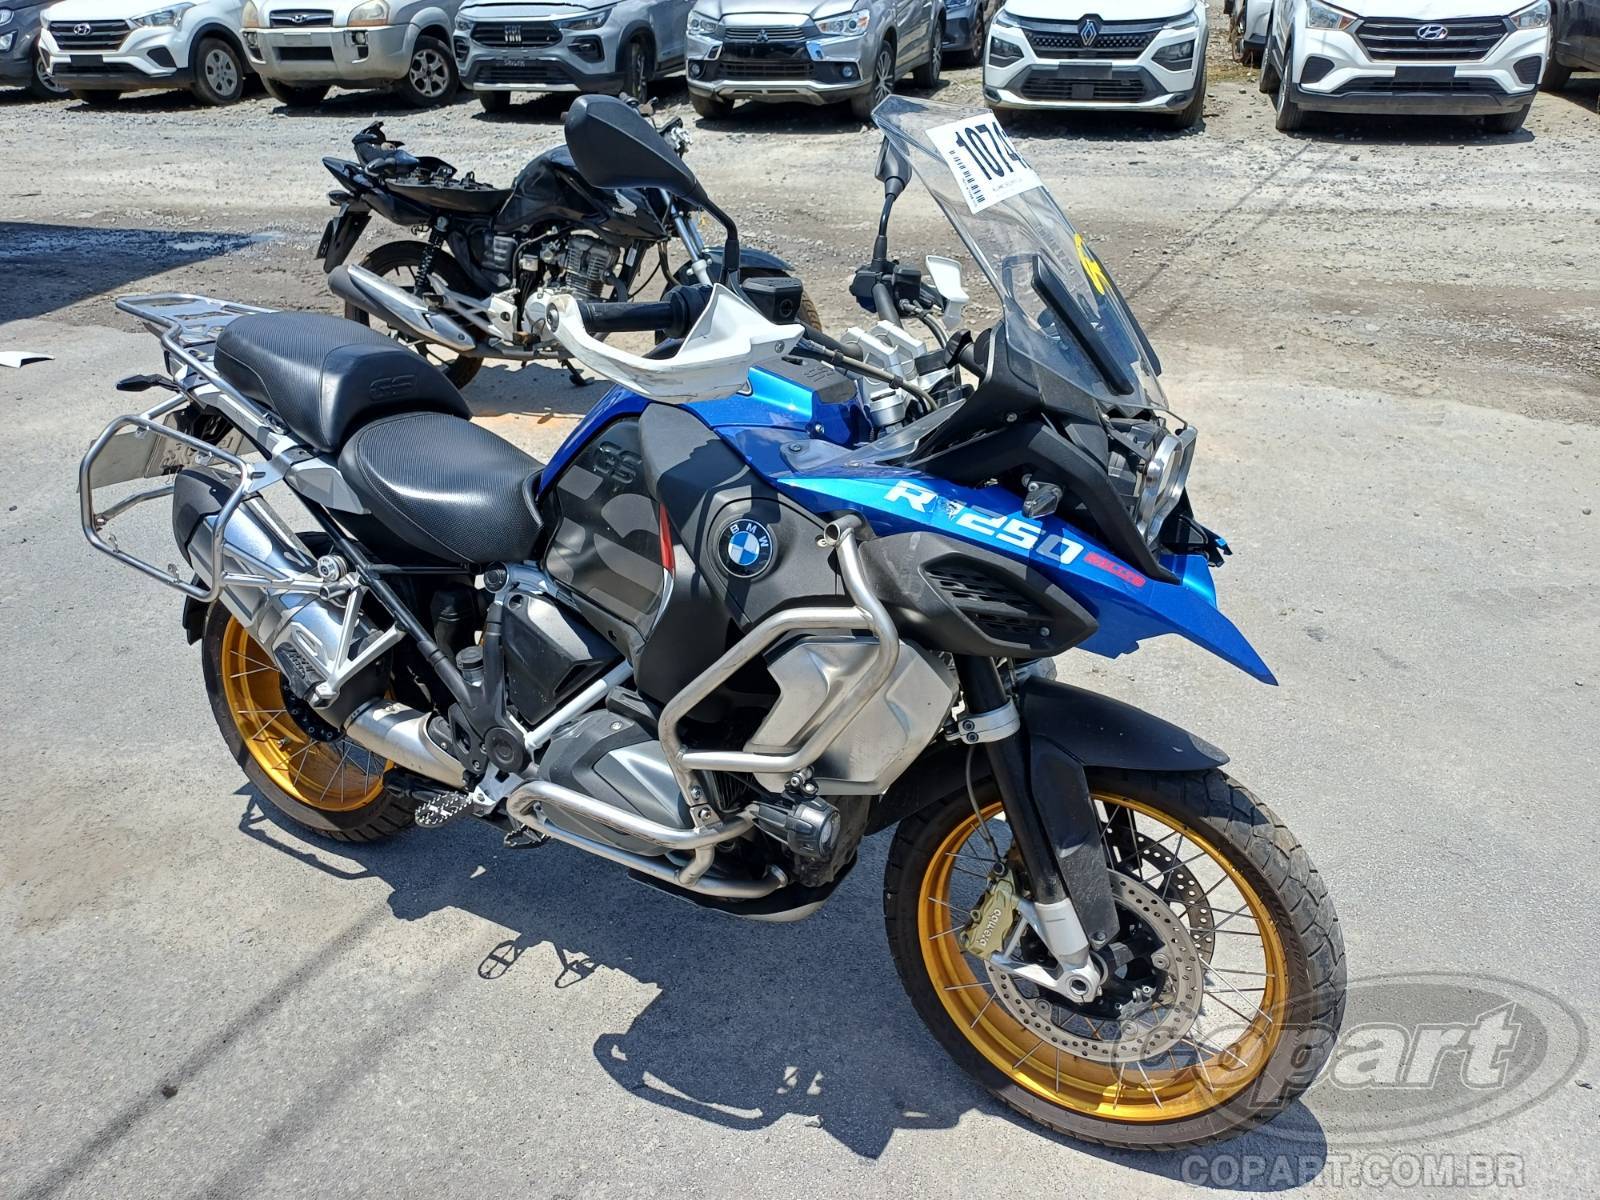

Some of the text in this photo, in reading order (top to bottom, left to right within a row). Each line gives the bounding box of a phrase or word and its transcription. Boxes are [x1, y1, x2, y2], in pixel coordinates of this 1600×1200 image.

[955, 121, 1031, 180] 1074
[730, 523, 769, 547] BMW
[979, 908, 1002, 947] brembo
